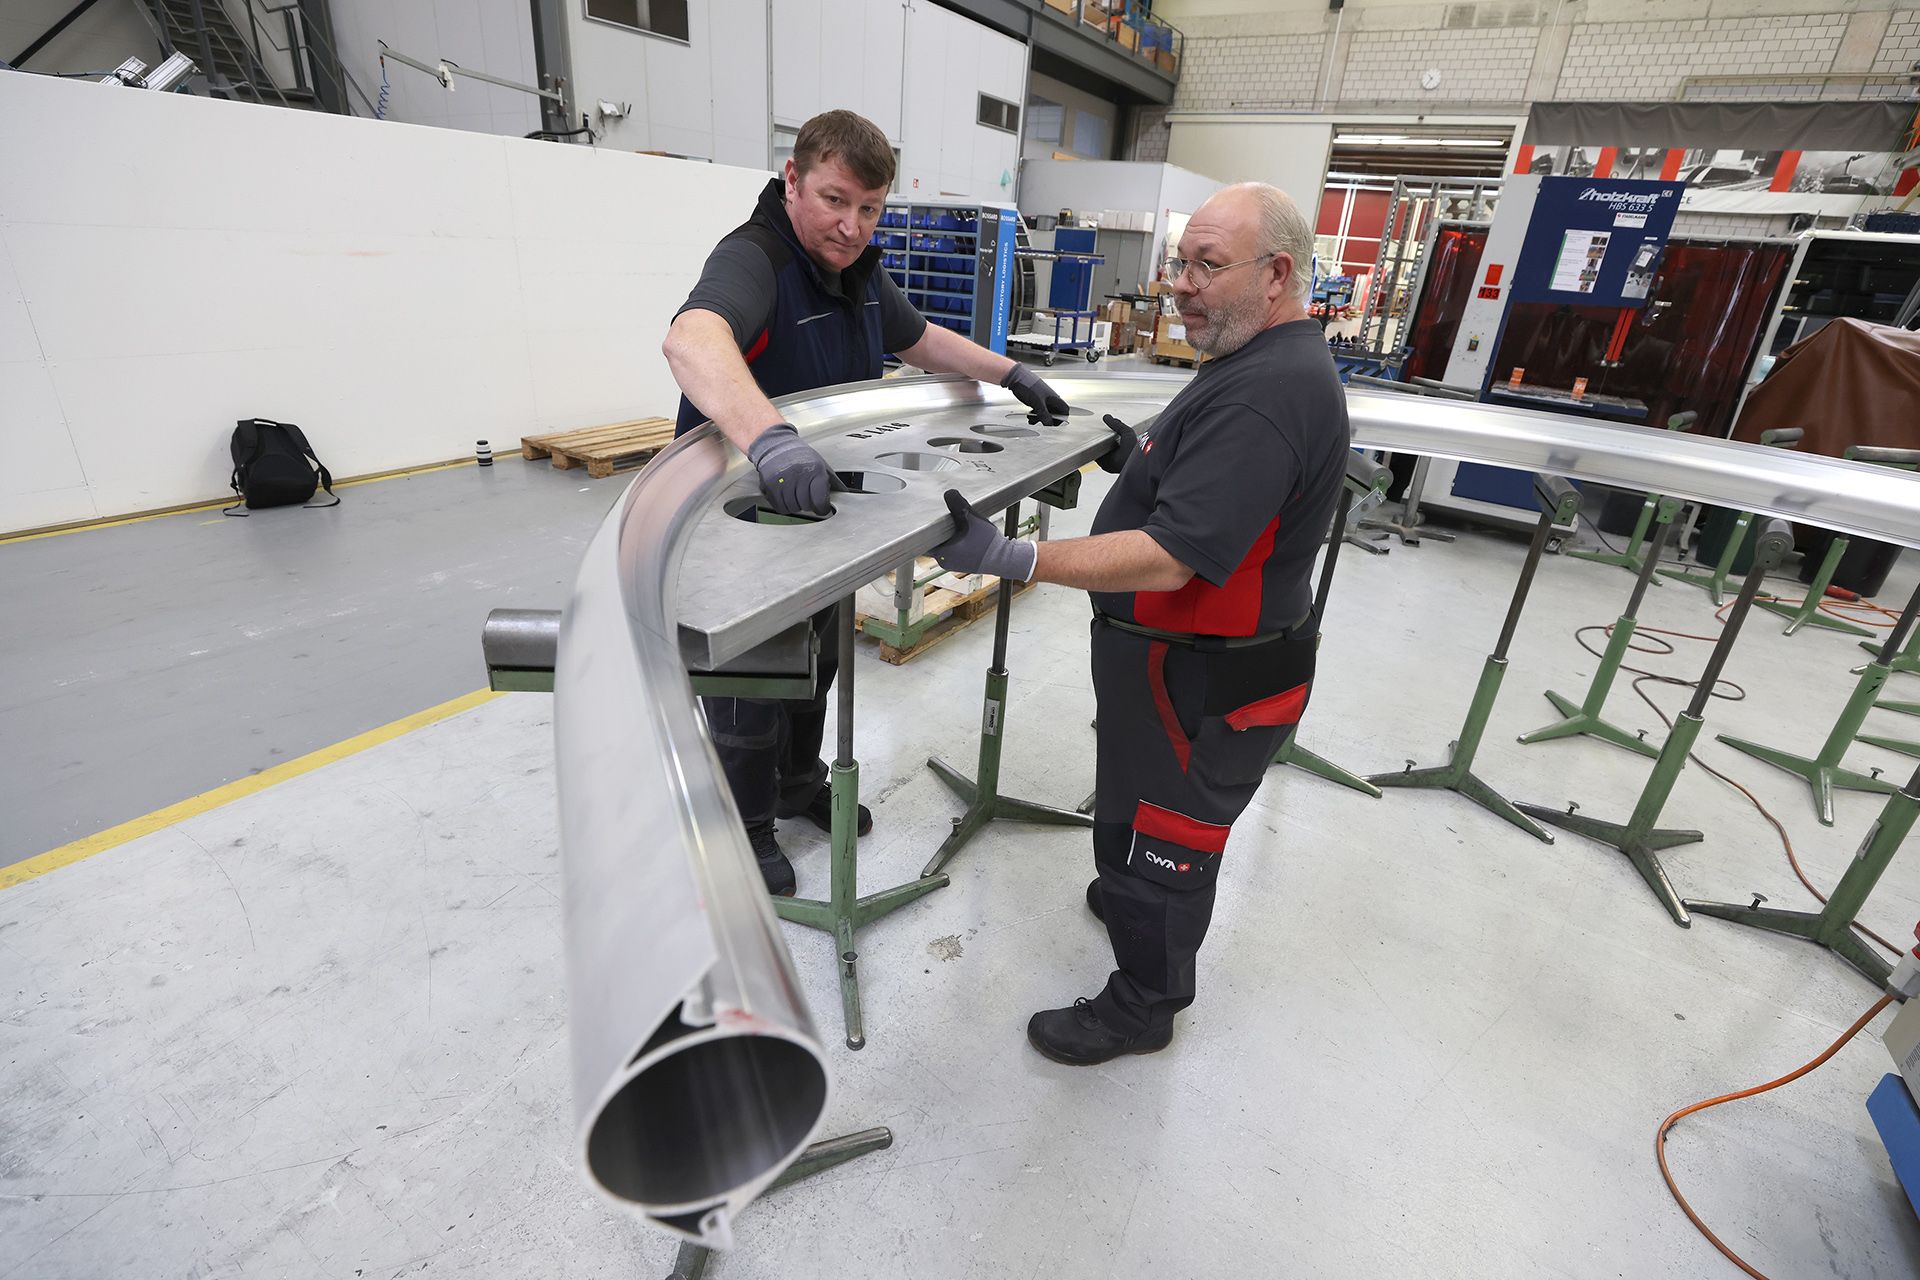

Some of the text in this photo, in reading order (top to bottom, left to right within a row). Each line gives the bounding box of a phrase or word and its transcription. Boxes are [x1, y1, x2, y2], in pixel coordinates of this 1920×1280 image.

[1589, 188, 1659, 203] holzkraft
[1608, 202, 1653, 212] HBS 633 S
[1479, 288, 1498, 299] 133
[1145, 850, 1177, 872] CWA
